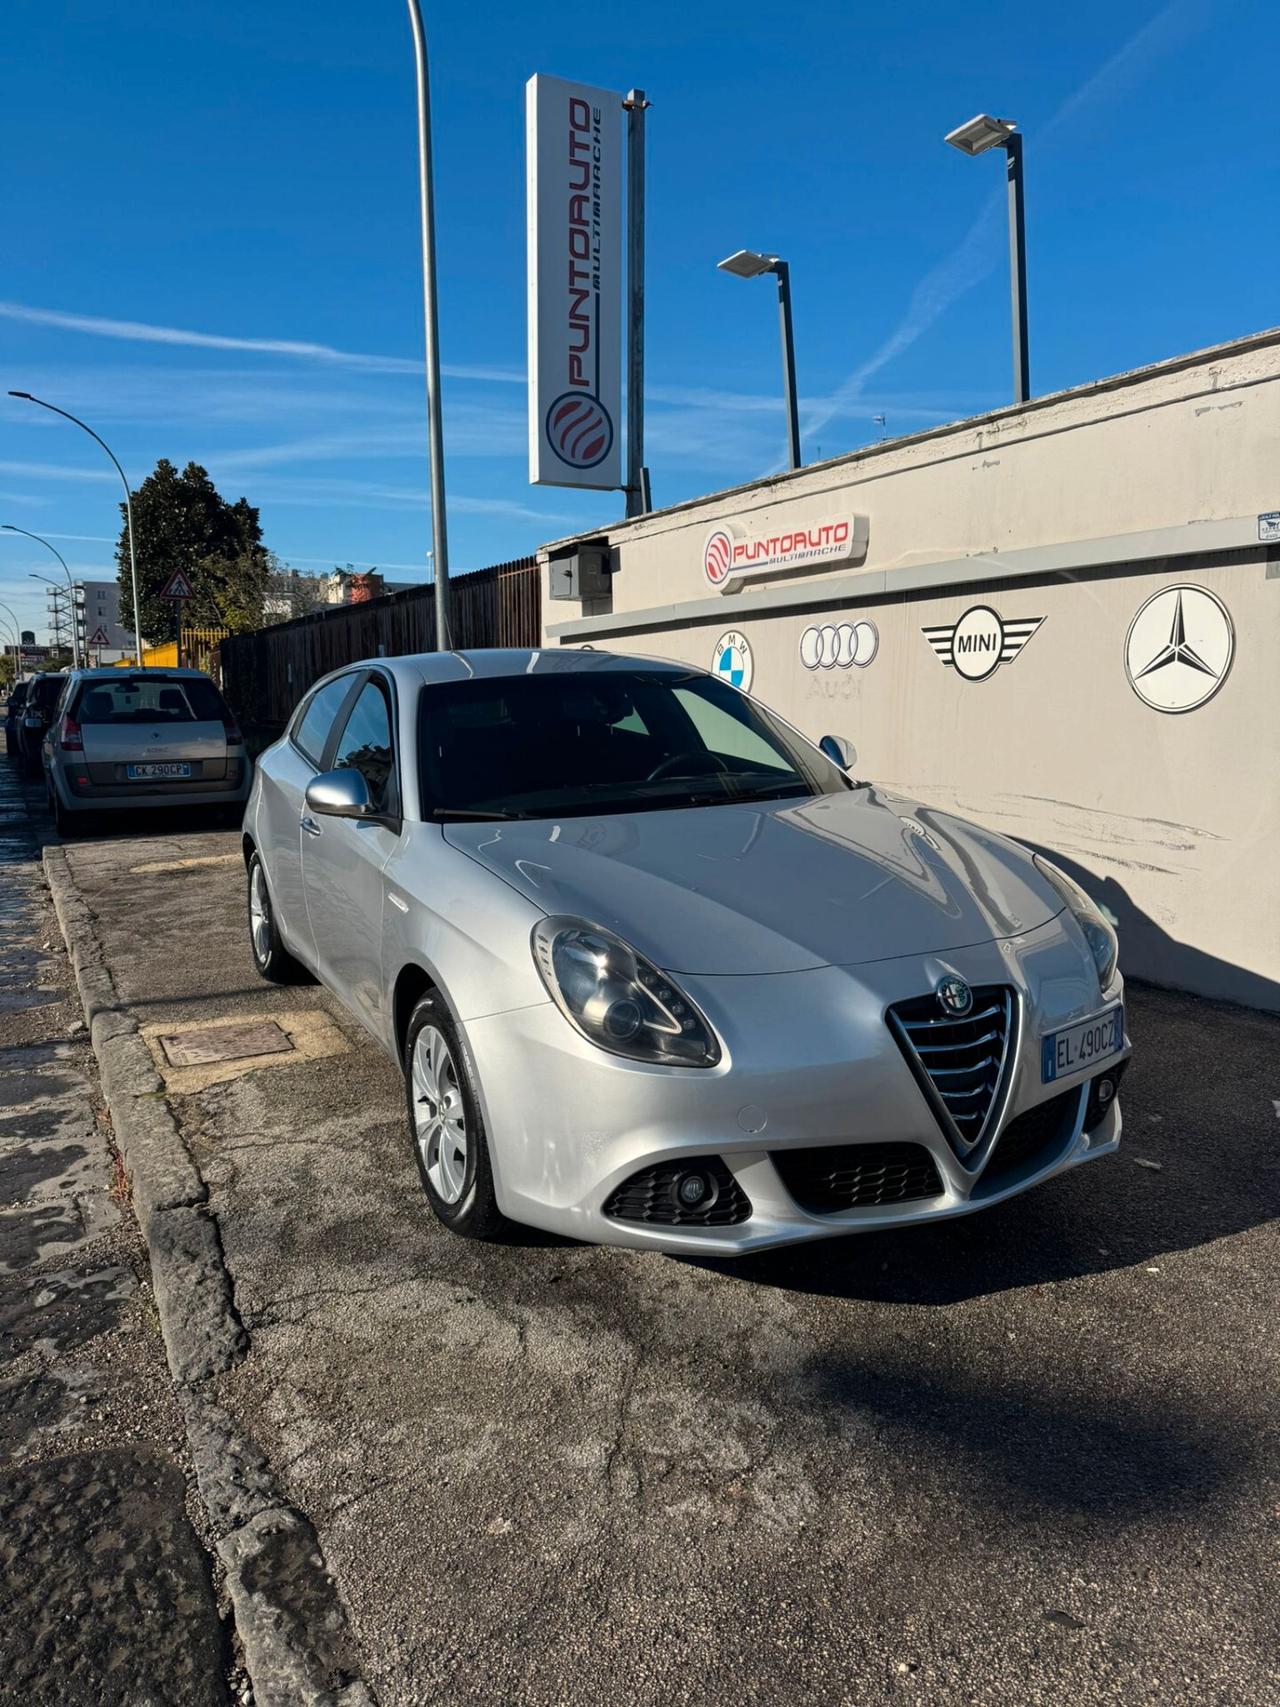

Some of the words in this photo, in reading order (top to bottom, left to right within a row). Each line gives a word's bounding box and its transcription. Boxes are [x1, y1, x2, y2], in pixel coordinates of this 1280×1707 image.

[592, 107, 602, 293] MULTIMARCHE
[569, 97, 591, 387] PUNTOAUTO
[733, 522, 849, 563] PUNTOAUTO
[768, 543, 847, 565] MULTIMARCHE
[717, 634, 748, 656] BMW
[958, 633, 996, 653] MINI
[135, 765, 149, 776] CK
[151, 764, 182, 776] 290CP
[1057, 1038, 1074, 1069] EL
[1079, 1020, 1115, 1060] 490CZ
